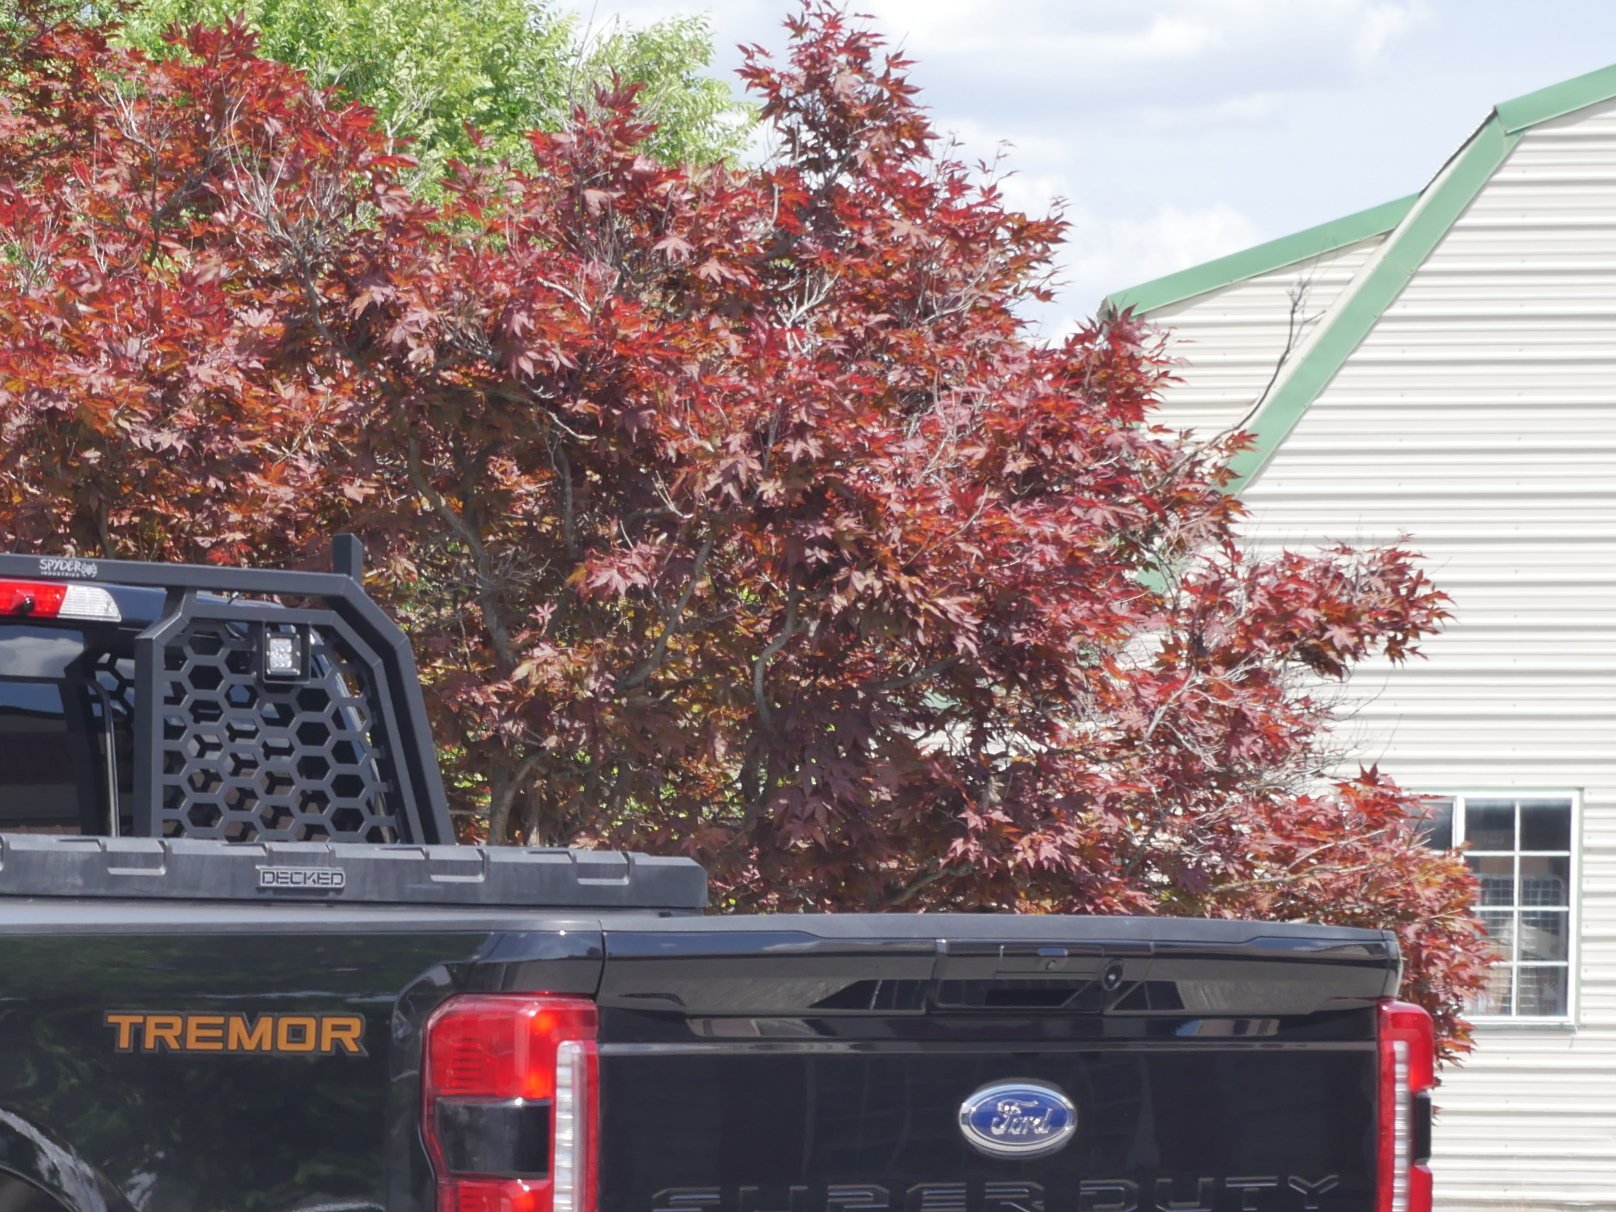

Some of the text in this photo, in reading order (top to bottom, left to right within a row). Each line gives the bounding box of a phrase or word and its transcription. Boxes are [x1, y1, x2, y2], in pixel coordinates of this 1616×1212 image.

[39, 558, 81, 572] SPYDER
[262, 871, 344, 886] DECKED
[105, 1013, 366, 1055] TREMOR
[990, 1099, 1053, 1136] Ford
